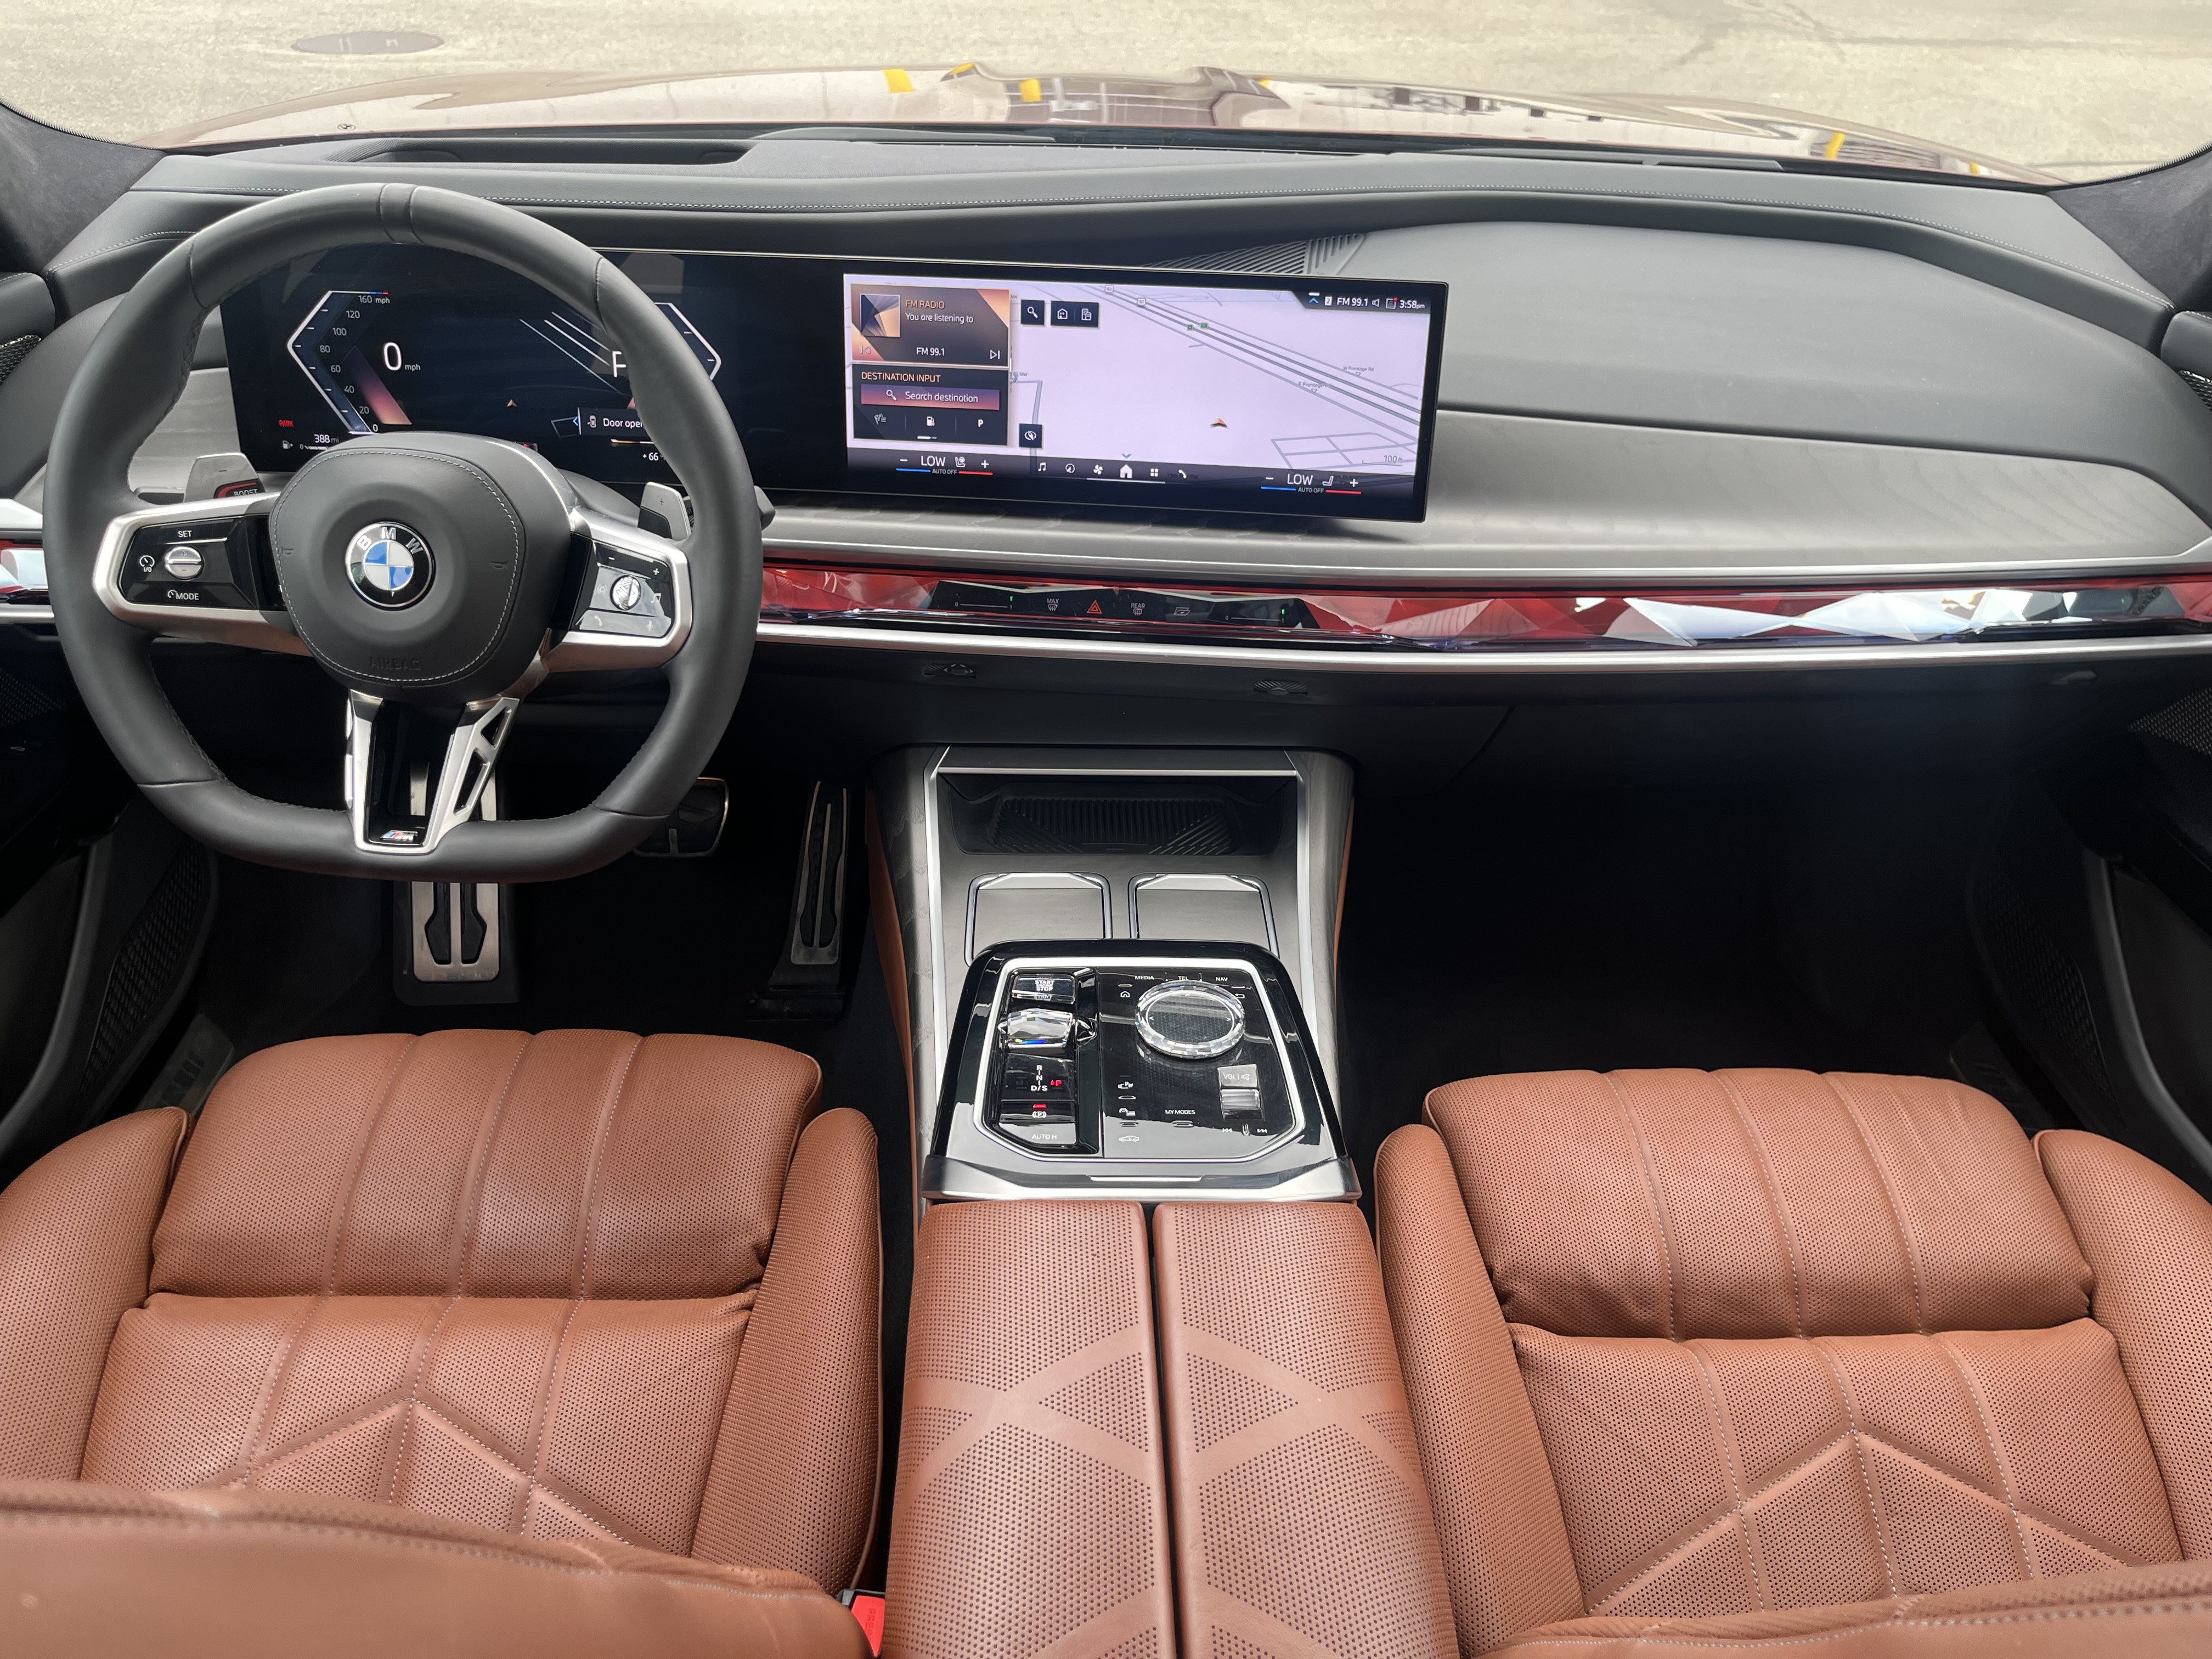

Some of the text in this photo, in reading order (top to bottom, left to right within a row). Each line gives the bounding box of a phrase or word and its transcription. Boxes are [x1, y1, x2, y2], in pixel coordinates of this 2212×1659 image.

[358, 295, 390, 305] 160 mph
[1337, 297, 1369, 307] FM 99.1
[919, 301, 945, 309] RADIO
[346, 310, 360, 319] 120
[905, 312, 919, 321] You
[934, 314, 964, 324] listening
[332, 328, 347, 336] 100
[320, 345, 330, 353] 80
[916, 347, 945, 356] FM 99.1
[383, 342, 421, 372] 0 mph
[331, 364, 341, 373] 60
[861, 371, 941, 383] DESTINATION INPUT
[344, 385, 355, 394] 40
[905, 391, 979, 403] Search destination
[359, 406, 370, 415] 20
[603, 417, 623, 427] Door
[373, 424, 379, 432] 0
[314, 434, 330, 443] 388
[921, 455, 946, 467] LOW
[1384, 455, 1397, 463] 100
[1287, 473, 1313, 486] LOW
[357, 527, 424, 555] BMW
[176, 592, 200, 601] MODE
[1222, 1071, 1236, 1080] VOL
